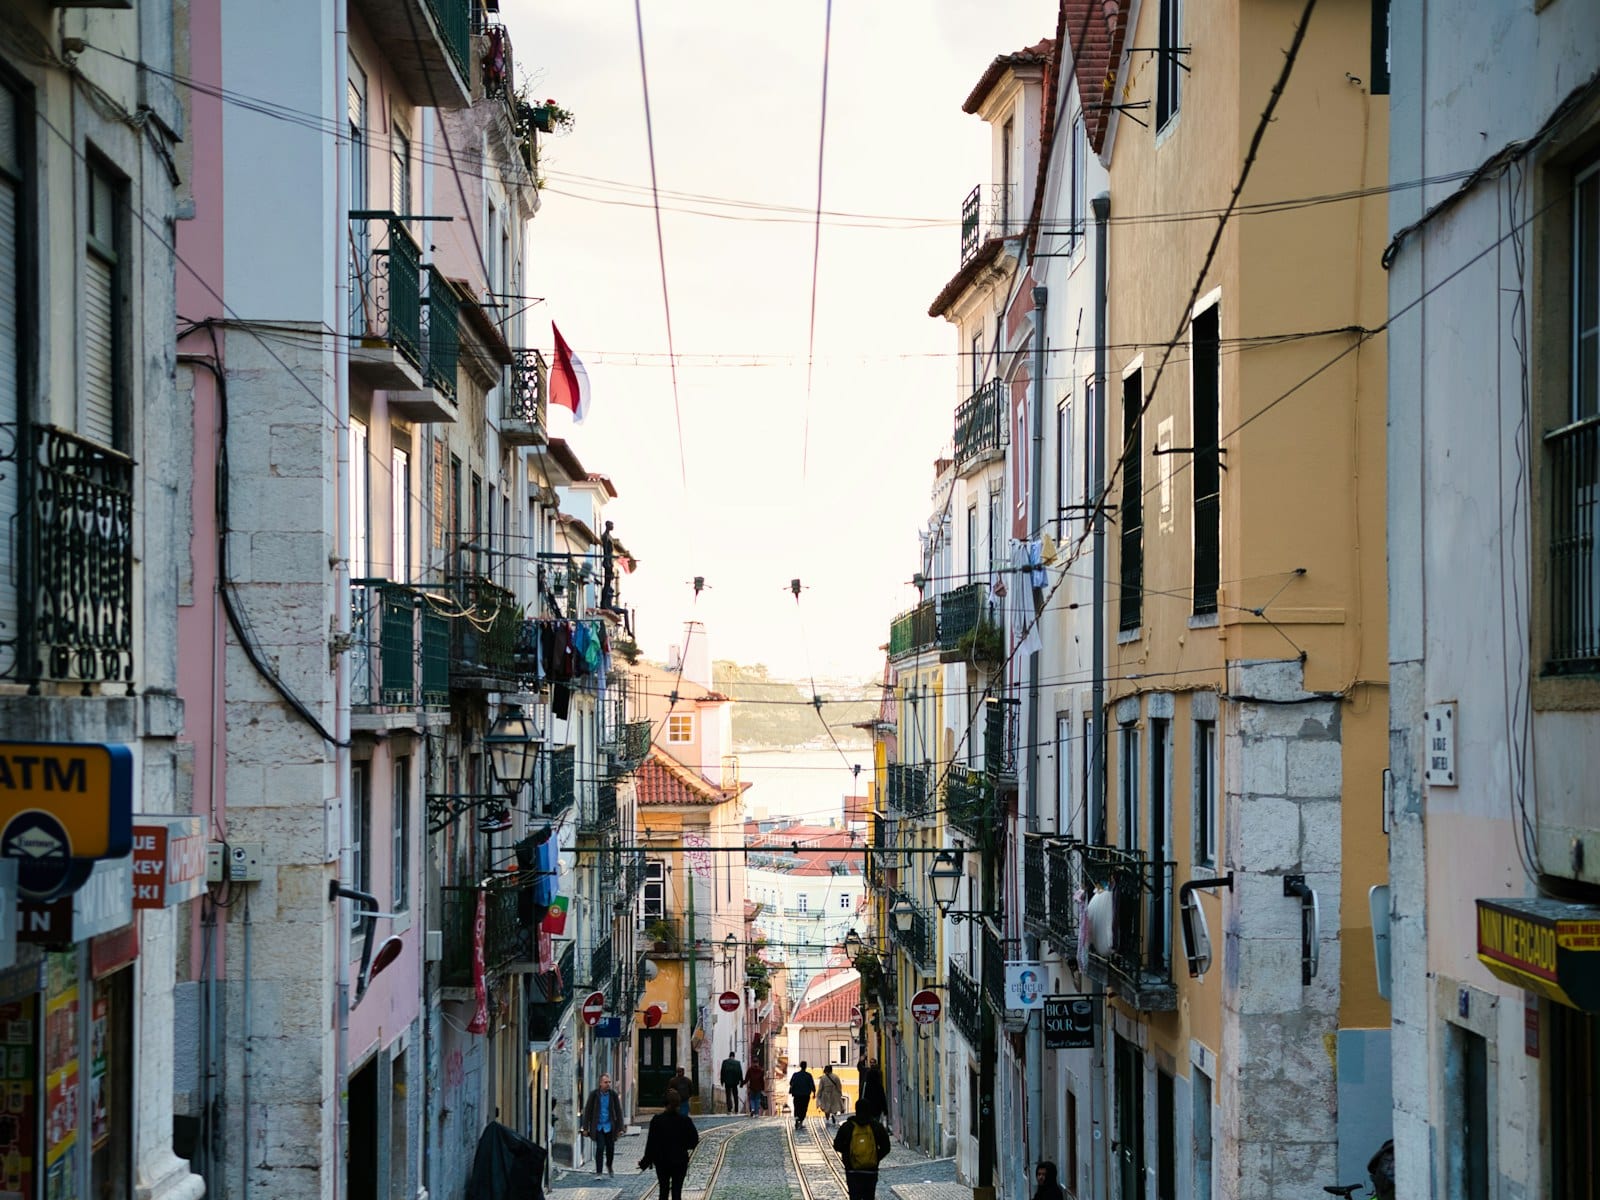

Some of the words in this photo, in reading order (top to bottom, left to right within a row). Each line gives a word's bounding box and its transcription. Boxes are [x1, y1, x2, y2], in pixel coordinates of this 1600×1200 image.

[1503, 913, 1556, 972] MERCADO
[1046, 1003, 1069, 1017] BICA
[1046, 1018, 1073, 1032] SOUR
